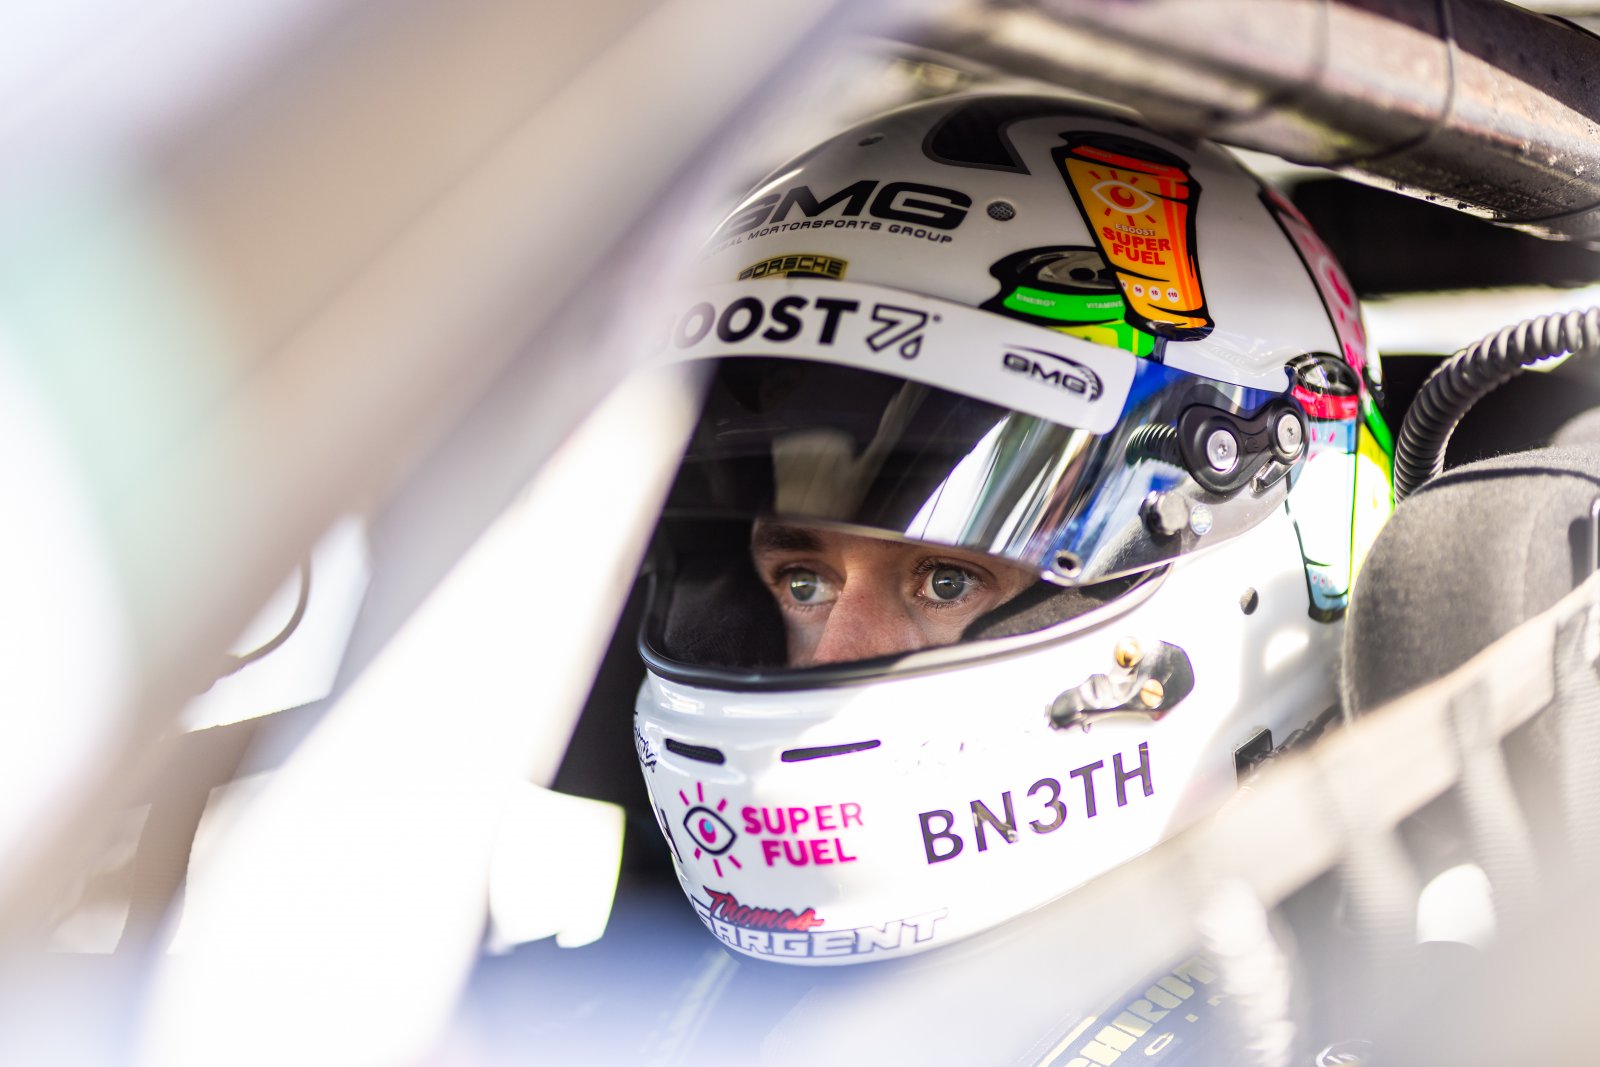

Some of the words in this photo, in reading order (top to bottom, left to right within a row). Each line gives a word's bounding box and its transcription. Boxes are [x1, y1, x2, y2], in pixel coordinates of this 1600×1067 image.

[747, 219, 882, 241] MORTORSPORTS
[888, 224, 953, 244] GROUP
[1102, 226, 1172, 252] SUPER
[1115, 223, 1156, 237] EBOOST
[738, 256, 845, 280] PORSCHE
[1112, 242, 1166, 266] FUEL
[666, 296, 860, 350] OOST
[1003, 351, 1089, 395] GMG
[741, 802, 864, 836] SUPER
[918, 741, 1155, 865] BN3TH
[760, 837, 858, 867] FUEL
[702, 884, 825, 932] Thomas
[690, 893, 949, 958] SARGENT
